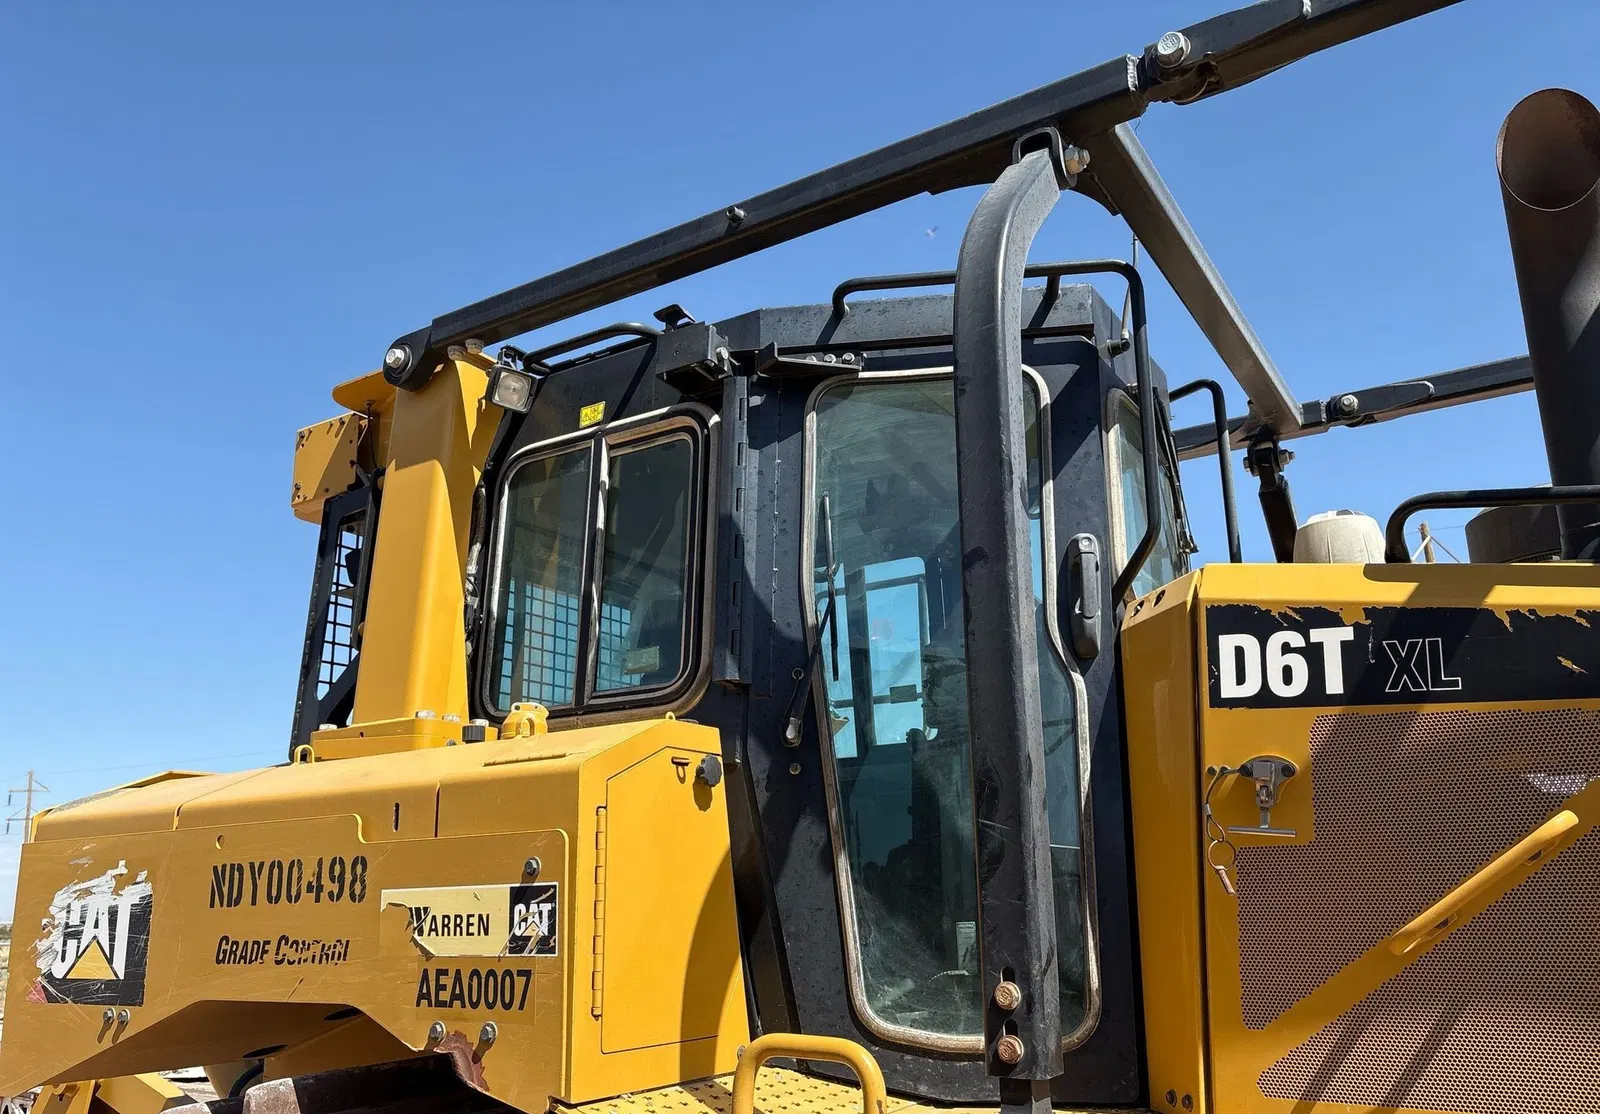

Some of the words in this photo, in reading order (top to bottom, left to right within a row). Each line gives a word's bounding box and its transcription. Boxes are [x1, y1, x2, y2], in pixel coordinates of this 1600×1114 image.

[1218, 626, 1354, 698] D6T
[1382, 637, 1462, 692] XL
[209, 855, 368, 908] NDY00498
[50, 893, 139, 980] CAT
[407, 906, 490, 937] WARREN
[513, 902, 552, 937] CAT
[415, 968, 532, 1011] AEA0007
